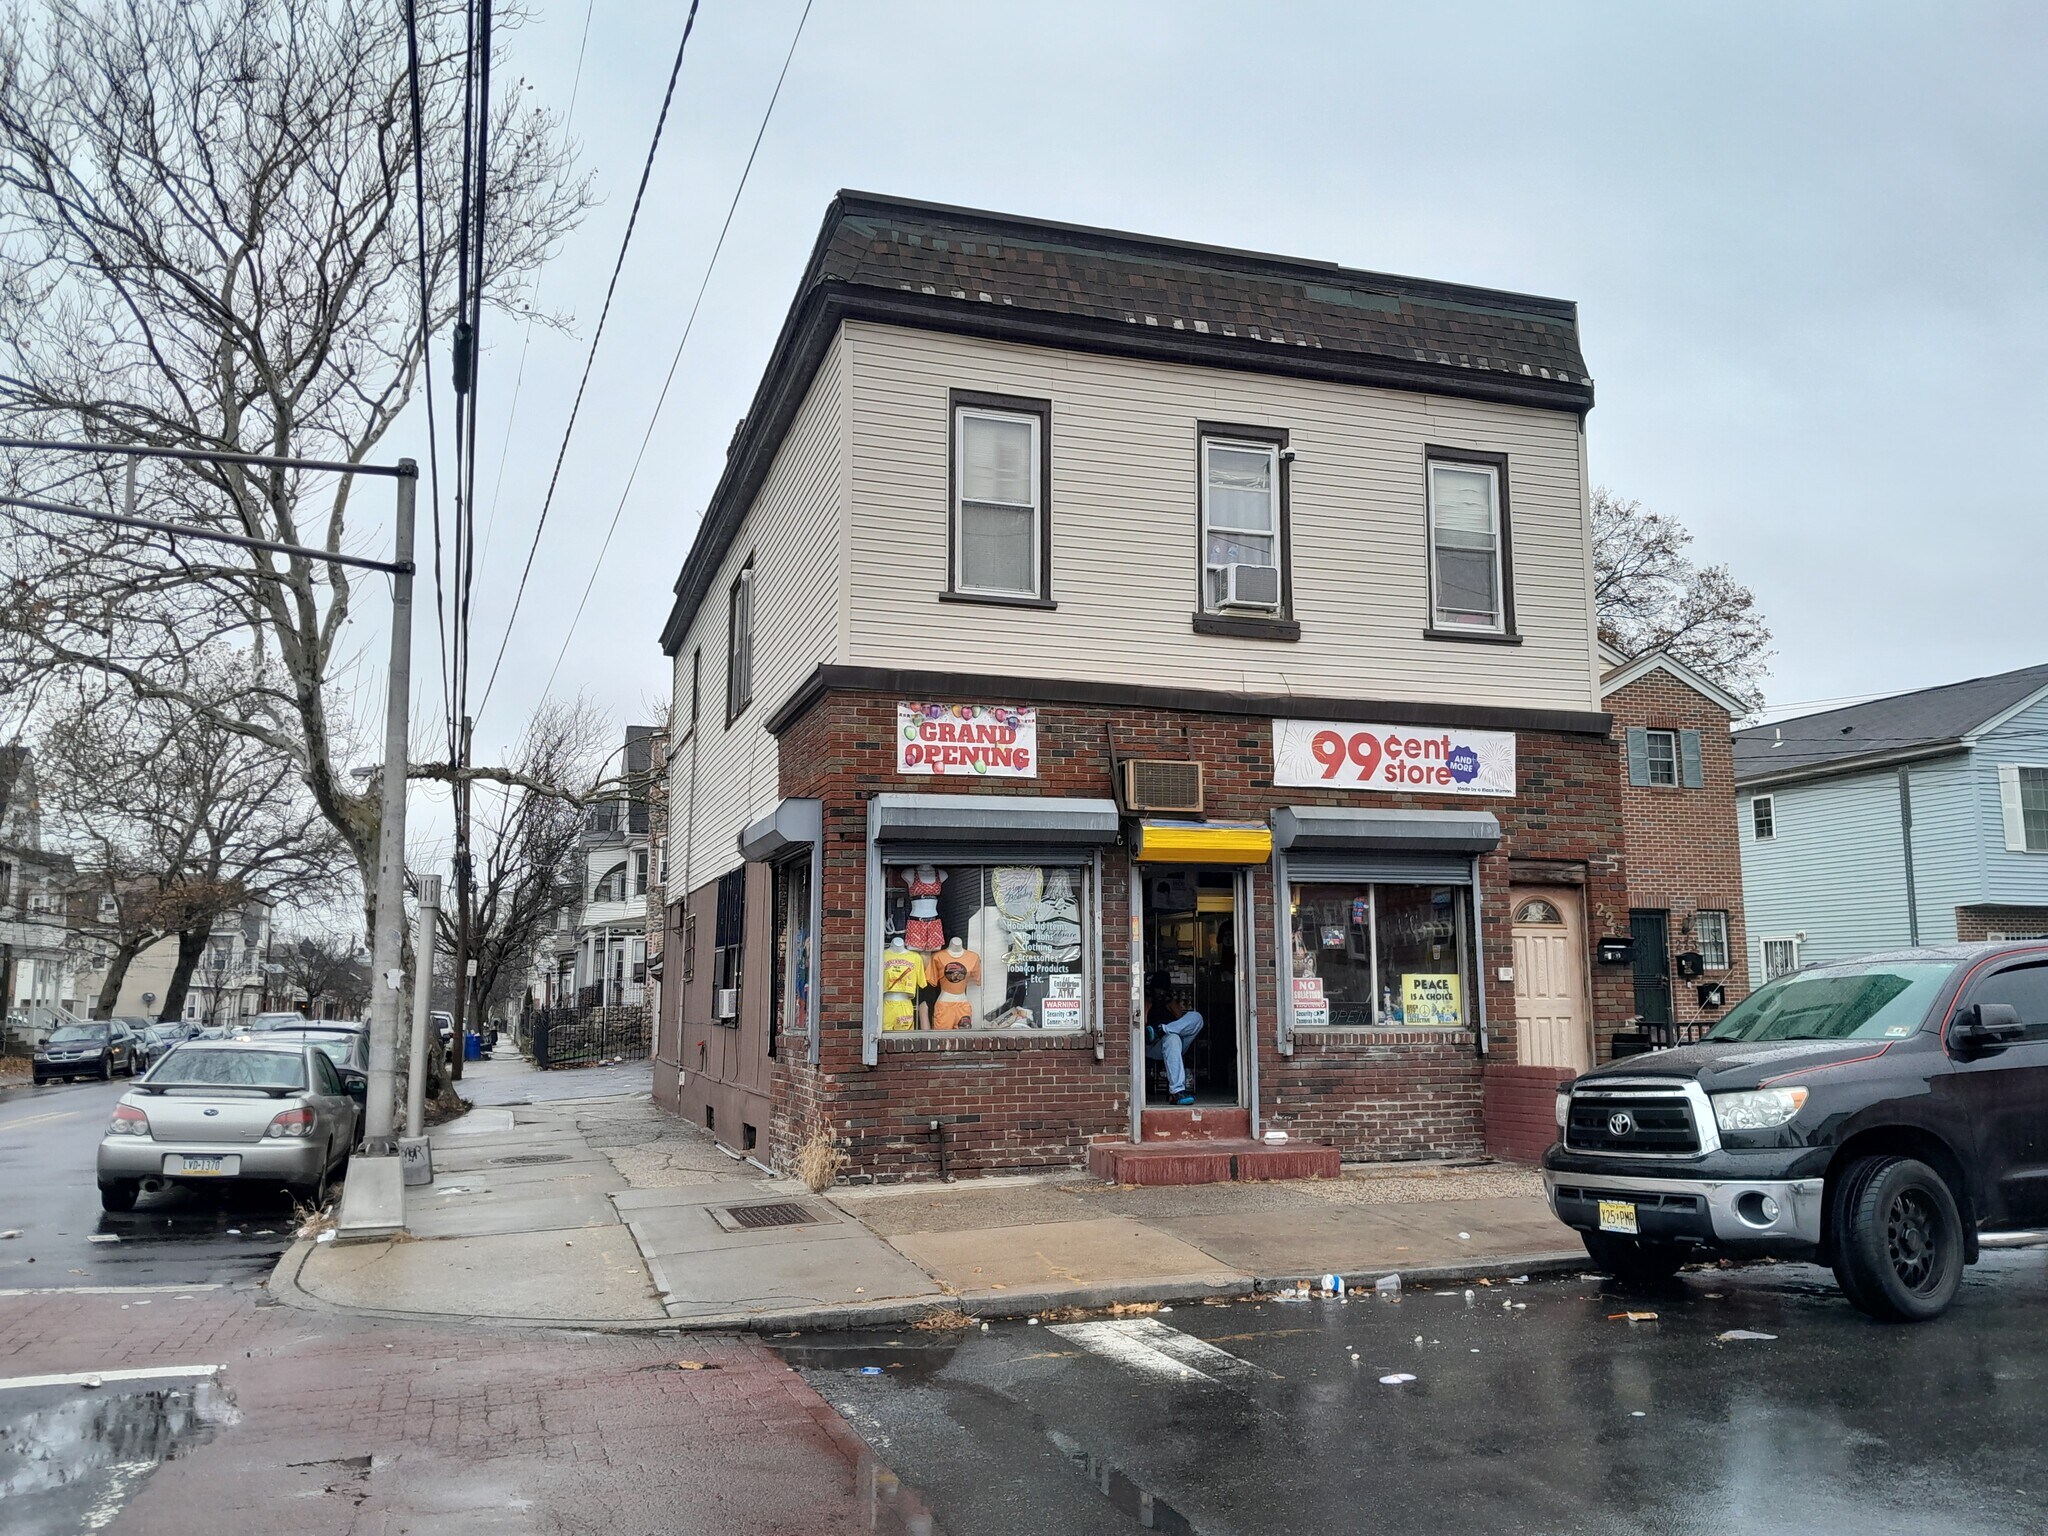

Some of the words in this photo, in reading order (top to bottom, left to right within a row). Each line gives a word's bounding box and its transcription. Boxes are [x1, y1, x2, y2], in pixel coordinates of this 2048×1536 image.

[919, 722, 1016, 745] GRAND
[905, 744, 1030, 768] OPENING
[1311, 730, 1382, 781] 99
[1454, 755, 1472, 765] AND
[1385, 759, 1451, 785] store
[1450, 762, 1473, 772] MORE
[1007, 922, 1046, 931] Household
[1046, 922, 1068, 931] Items
[1022, 933, 1054, 941] Balloons
[1022, 942, 1053, 952] Clothing
[1018, 953, 1058, 962] Accessories
[1007, 964, 1035, 973] Tobacco
[1037, 963, 1069, 973] Products
[1031, 974, 1044, 983] Etc.
[1299, 981, 1316, 990] NO
[1413, 979, 1449, 990] PEACE
[1058, 988, 1075, 998] ATM
[1426, 993, 1453, 1001] CHOICE
[1046, 1010, 1065, 1018] Security
[1329, 1010, 1369, 1024] OPEN
